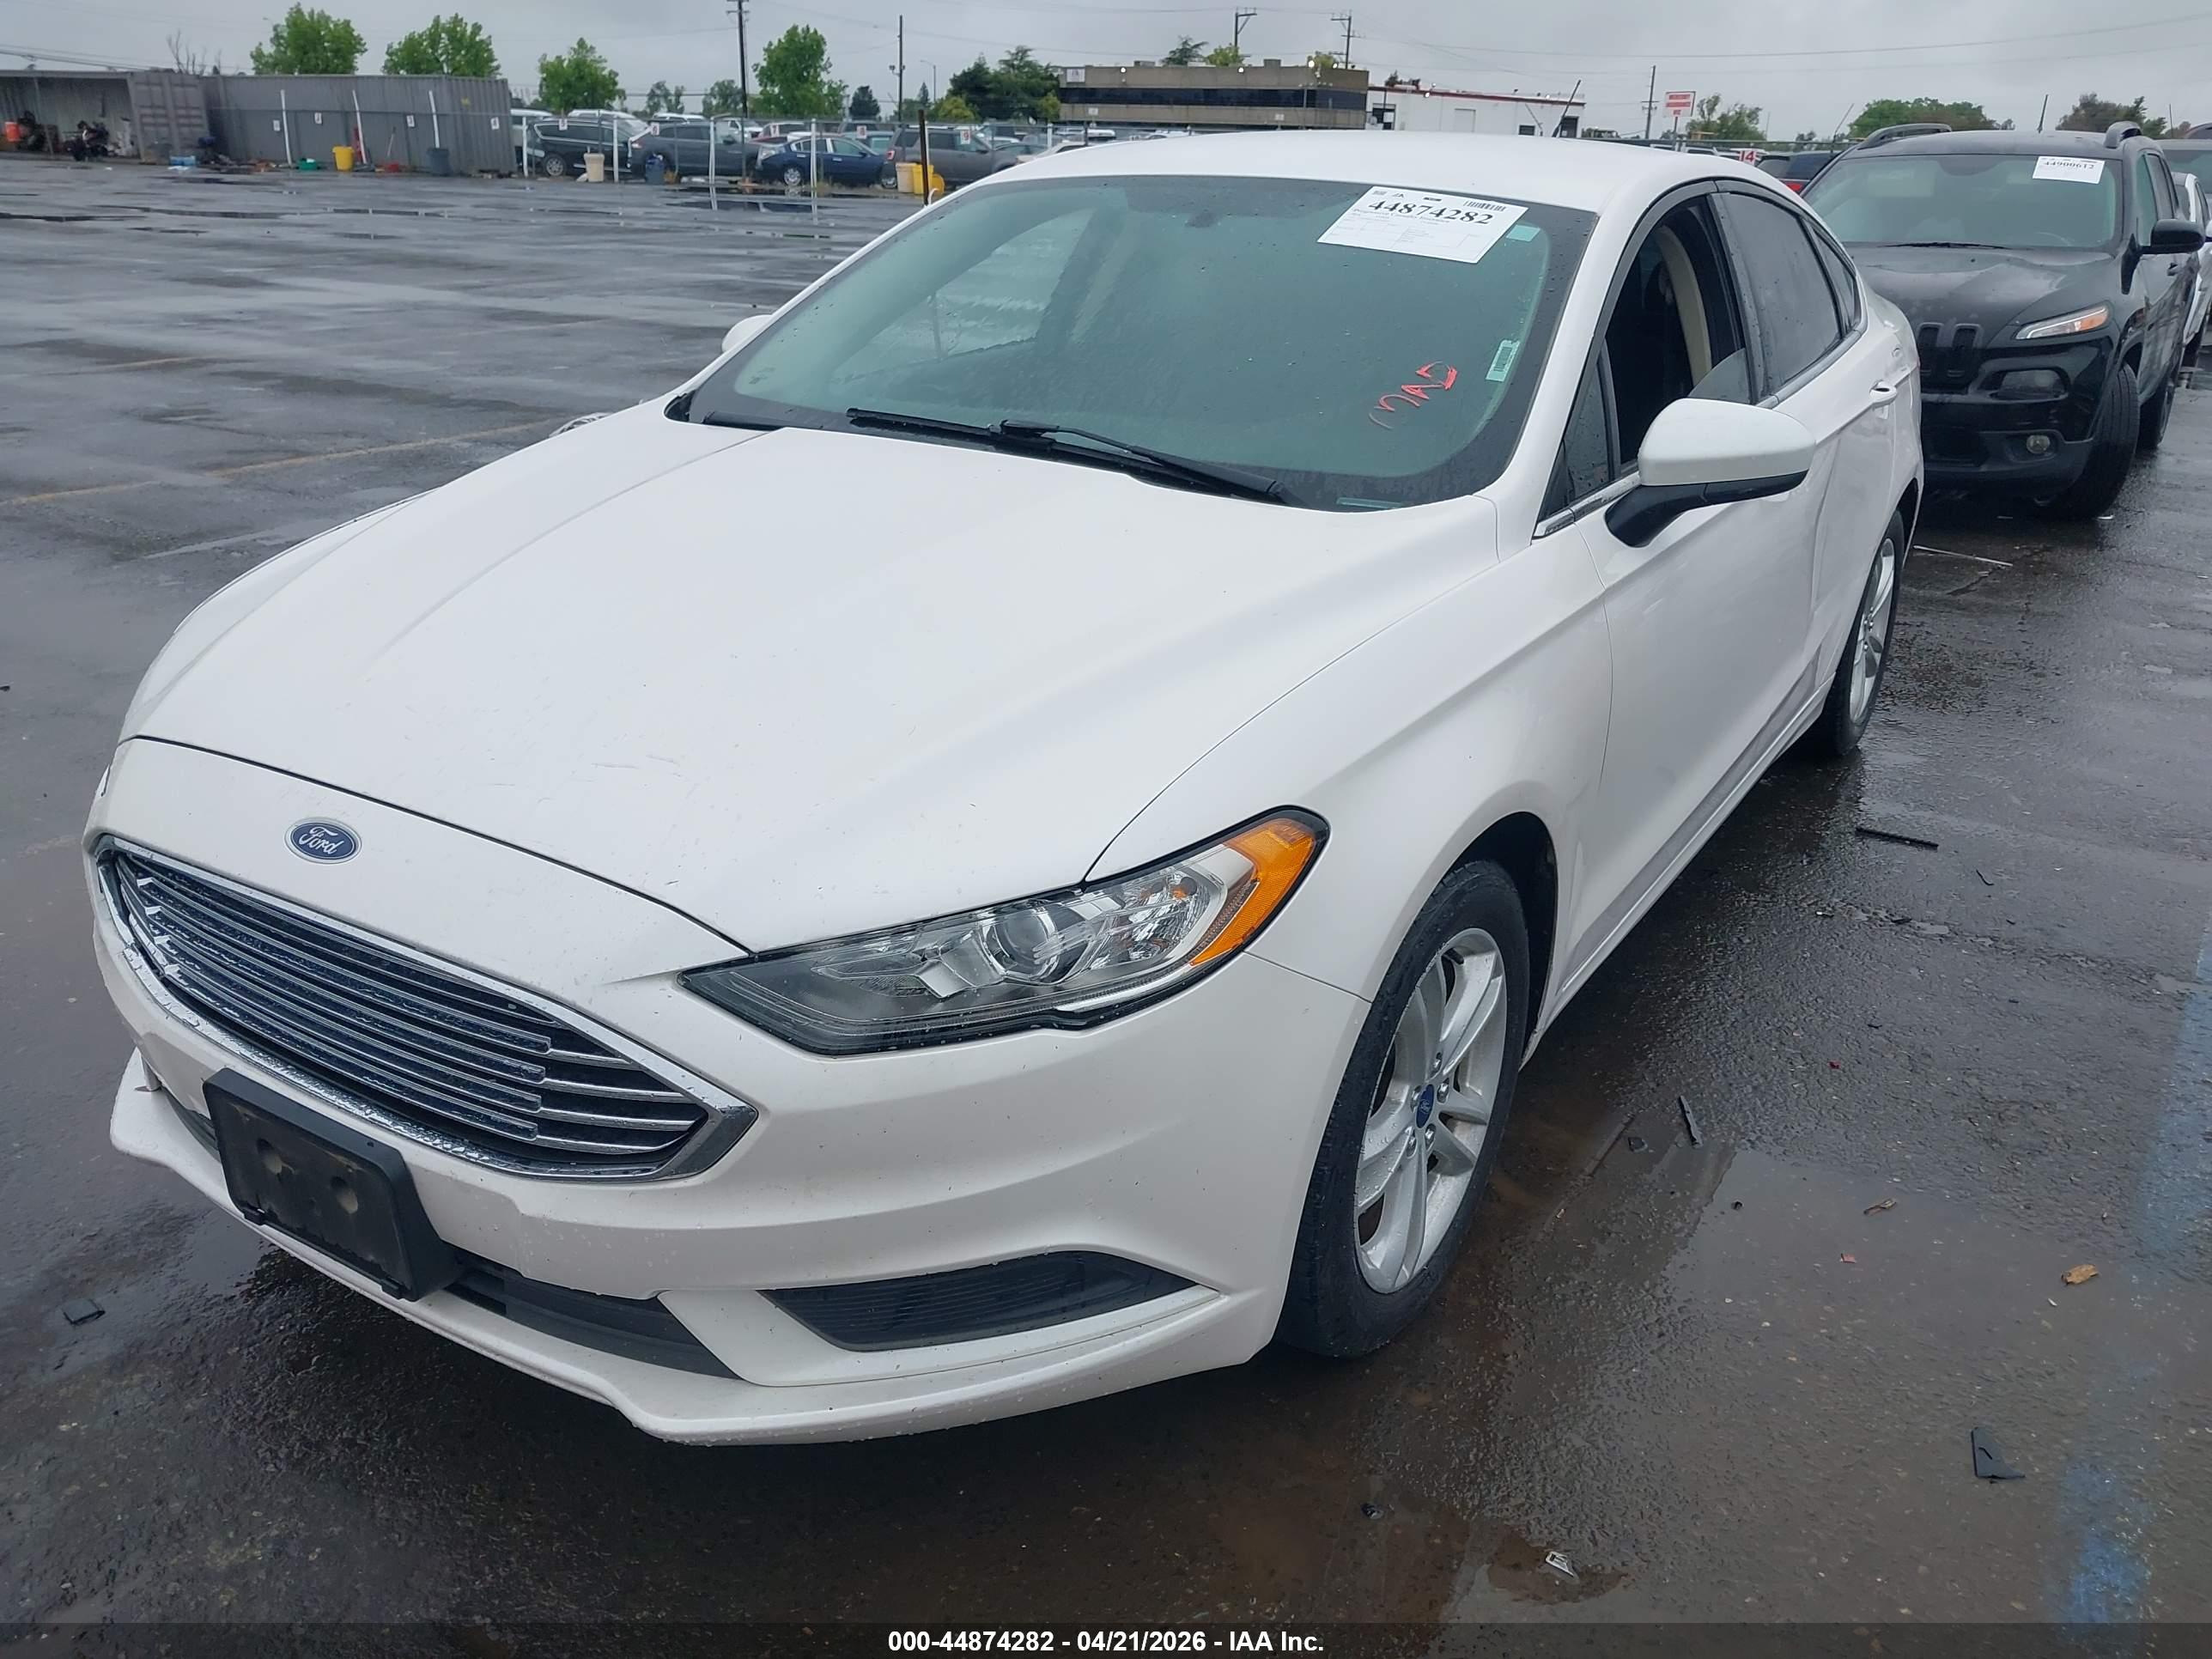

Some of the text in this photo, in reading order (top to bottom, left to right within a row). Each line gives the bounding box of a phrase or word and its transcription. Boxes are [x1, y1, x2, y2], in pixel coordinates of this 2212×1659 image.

[1741, 150, 1754, 162] 14
[1368, 200, 1493, 225] 44874282
[298, 826, 344, 854] Ford
